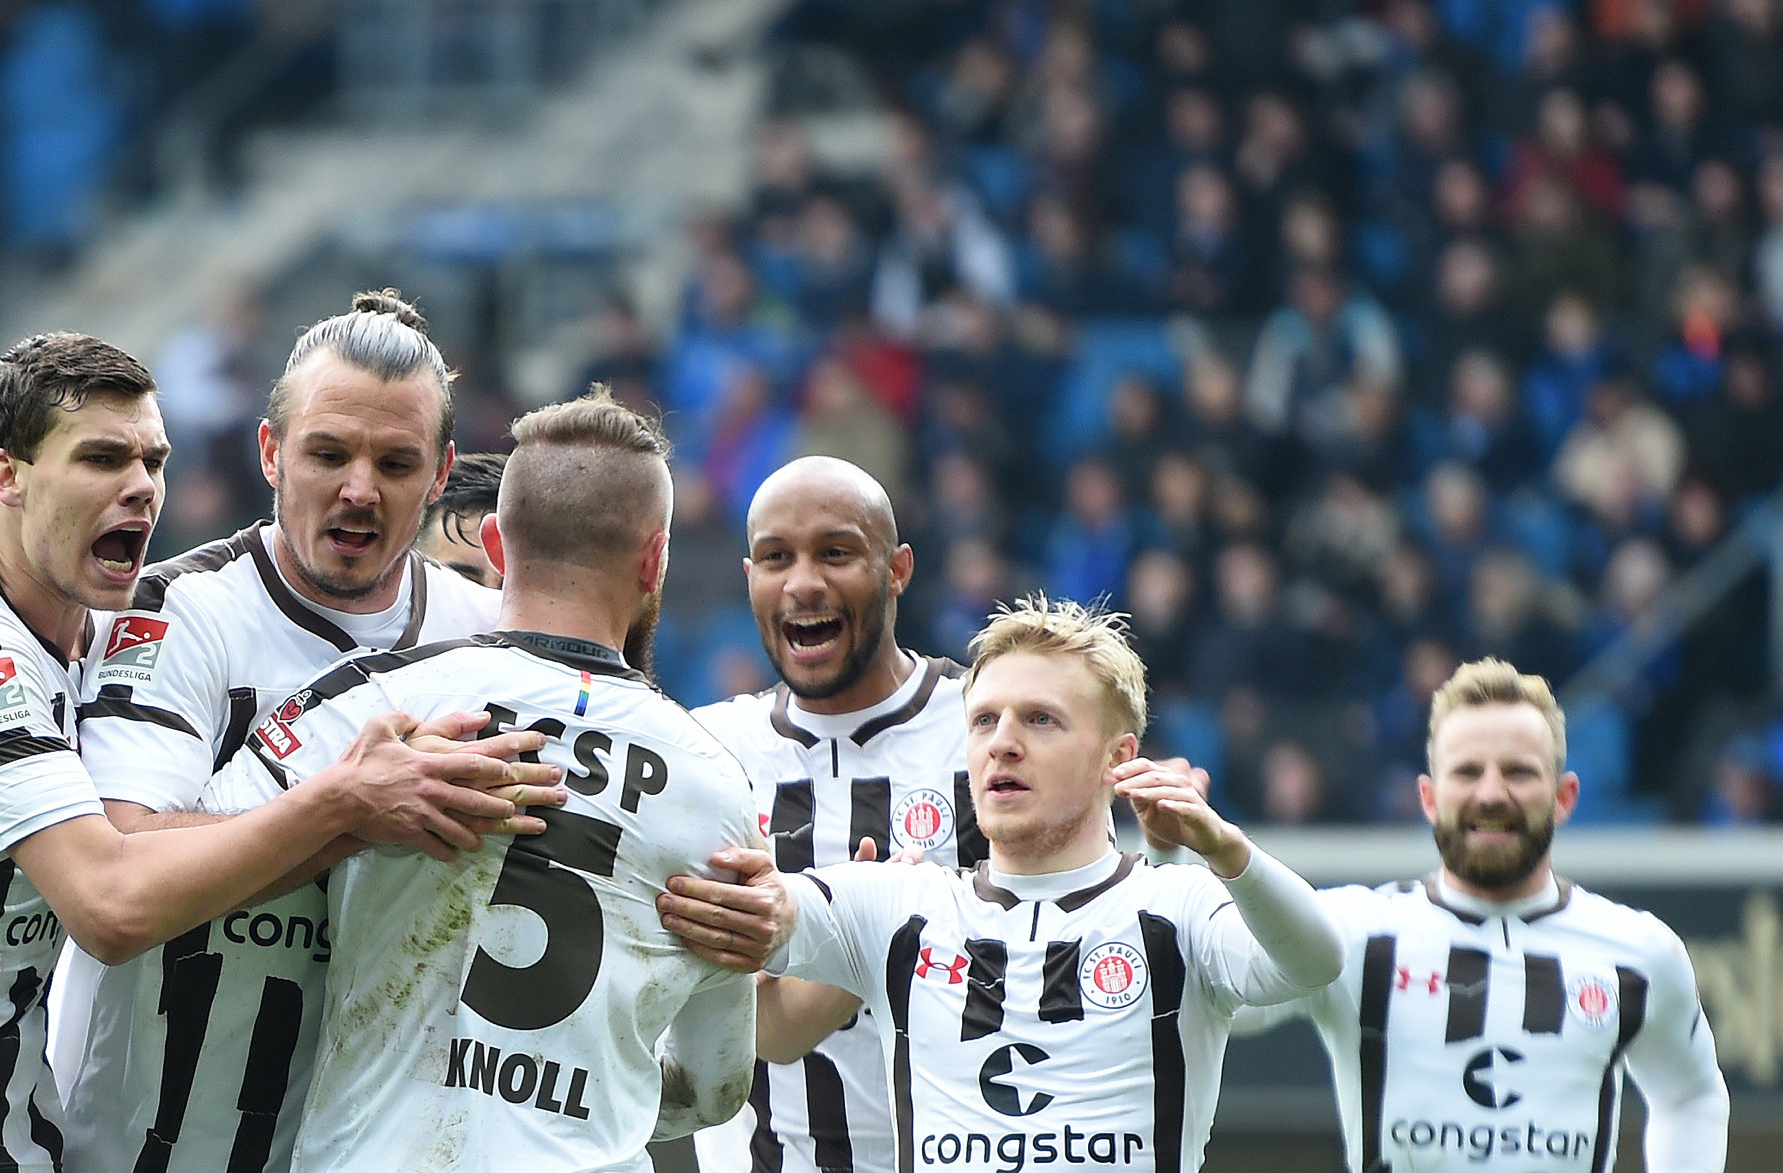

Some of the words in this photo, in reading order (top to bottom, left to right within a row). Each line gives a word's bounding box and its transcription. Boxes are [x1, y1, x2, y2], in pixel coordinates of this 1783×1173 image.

[136, 642, 158, 665] 2
[522, 634, 610, 660] ARMOUR
[97, 669, 152, 682] BUNDESLIGA
[4, 680, 24, 704] 2
[922, 792, 950, 818] PAULI
[6, 910, 63, 950] con
[460, 804, 624, 1031] 5
[1108, 946, 1142, 969] PAULI
[1105, 992, 1131, 1005] 1910
[445, 1037, 591, 1121] KNOLL
[1390, 1118, 1589, 1164] congstar
